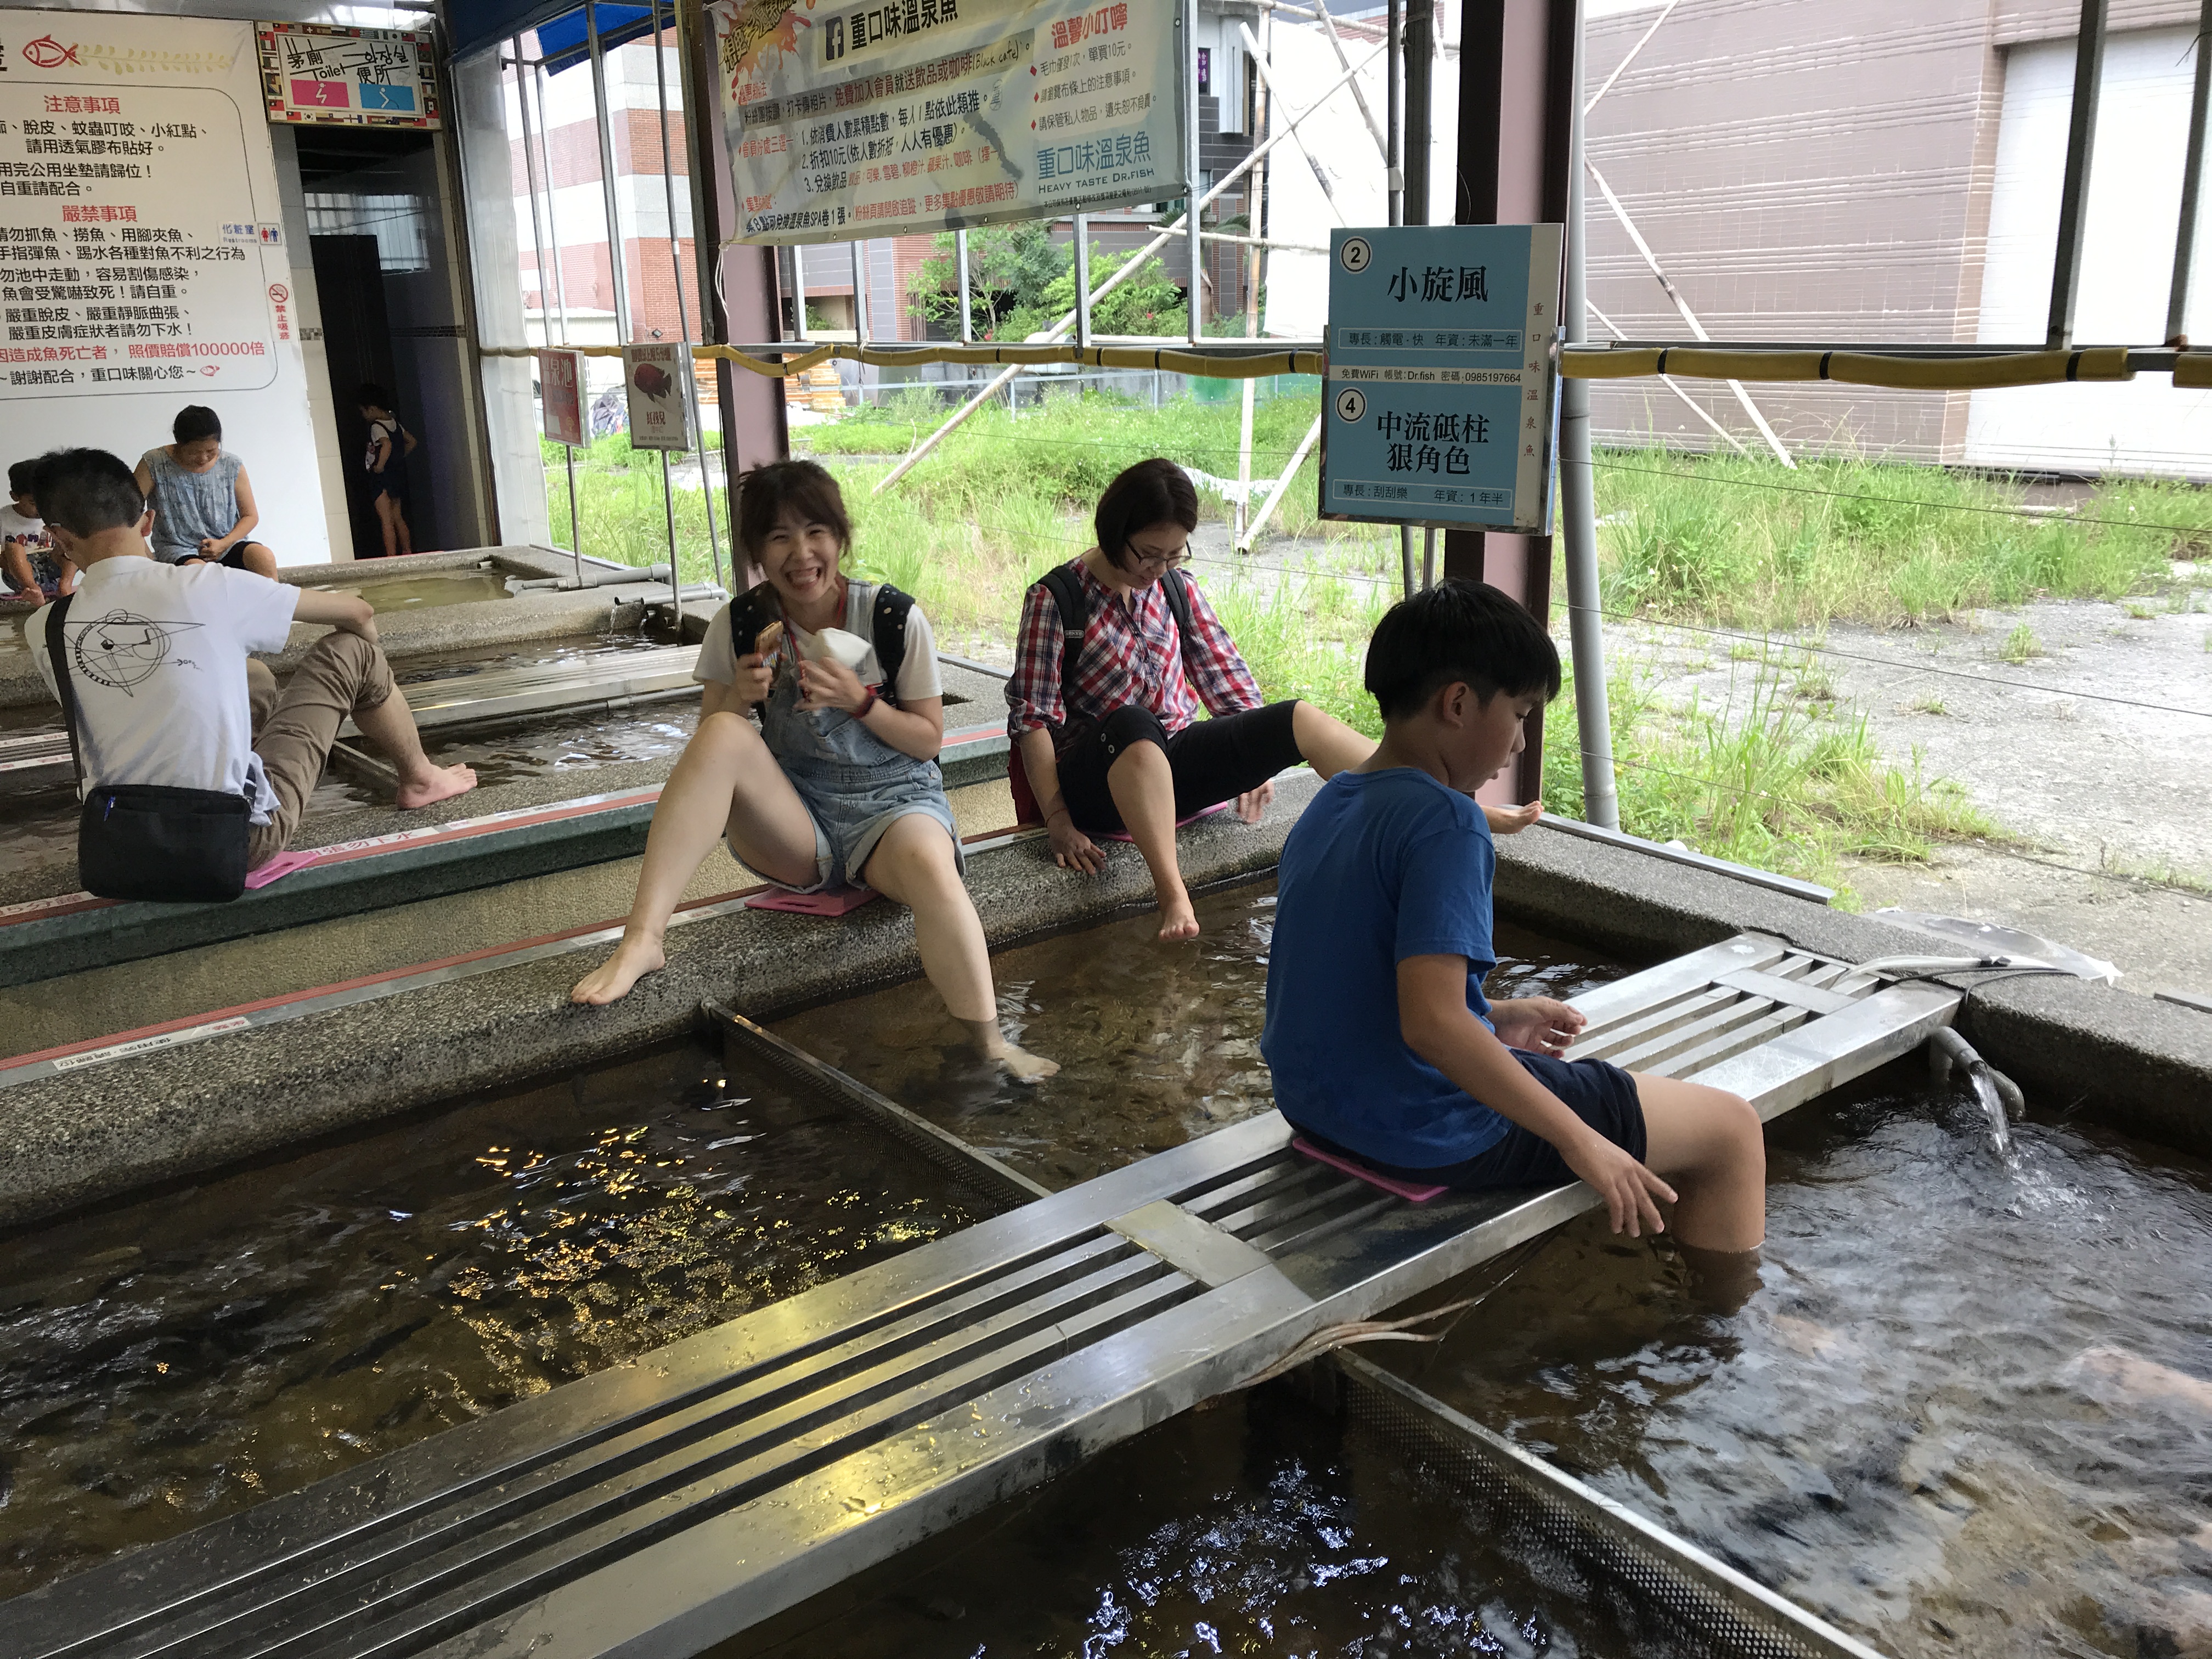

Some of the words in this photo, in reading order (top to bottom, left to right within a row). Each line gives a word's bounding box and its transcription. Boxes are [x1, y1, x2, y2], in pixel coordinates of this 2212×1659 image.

[850, 0, 958, 50] 重口味溫泉魚
[1051, 2, 1127, 49] 溫馨小叮嚀
[363, 43, 409, 65] 화장실
[297, 63, 346, 81] Toilet
[357, 64, 393, 86] 便所
[1040, 68, 1136, 103] 請瀏覽布條上的注意事項。
[44, 95, 121, 114] 注意事項
[1039, 93, 1156, 131] 請保管私人物品，遺失恕不負責。
[25, 138, 164, 155] 請用透氣膠布貼好。
[1036, 131, 1151, 180] 重口味溫泉魚
[1, 180, 92, 196] 自重請配合。
[1039, 182, 1071, 194] HEAVY
[1076, 176, 1108, 188] TASTE
[62, 205, 138, 223] 嚴禁事項
[1351, 246, 1361, 263] 2
[2, 285, 188, 301] 魚會受驚嚇致死！請自重。
[1387, 266, 1488, 302] 小旋風
[275, 304, 290, 340] 禁止吸菸
[9, 323, 192, 341] 嚴重皮膚症狀者請勿下水！
[128, 341, 265, 359] 照價賠償100000倍
[1341, 369, 1379, 380] 免費WiFi
[1523, 302, 1545, 458] 重口味溫泉魚
[1345, 397, 1356, 414] 4
[1376, 410, 1491, 444] 中流砥柱
[1386, 443, 1470, 475] 狠角色
[1343, 484, 1408, 499] 專長：刮刮樂
